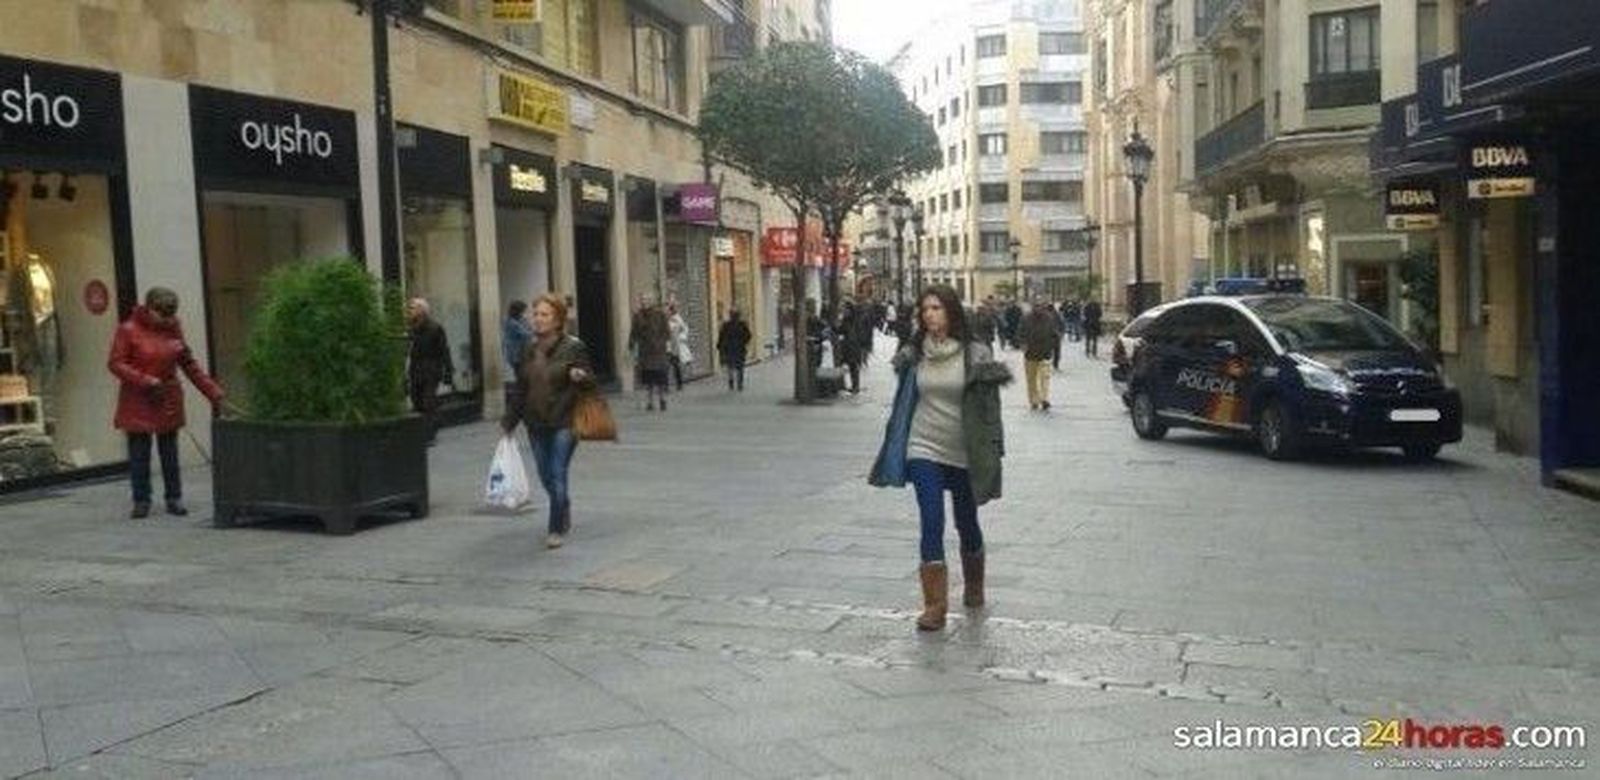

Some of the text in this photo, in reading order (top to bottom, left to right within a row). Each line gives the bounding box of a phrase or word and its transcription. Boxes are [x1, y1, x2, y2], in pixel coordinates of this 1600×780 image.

[241, 114, 333, 165] oysho
[1472, 146, 1529, 168] BBVA
[681, 196, 715, 209] GAME
[1390, 189, 1435, 206] BBVA
